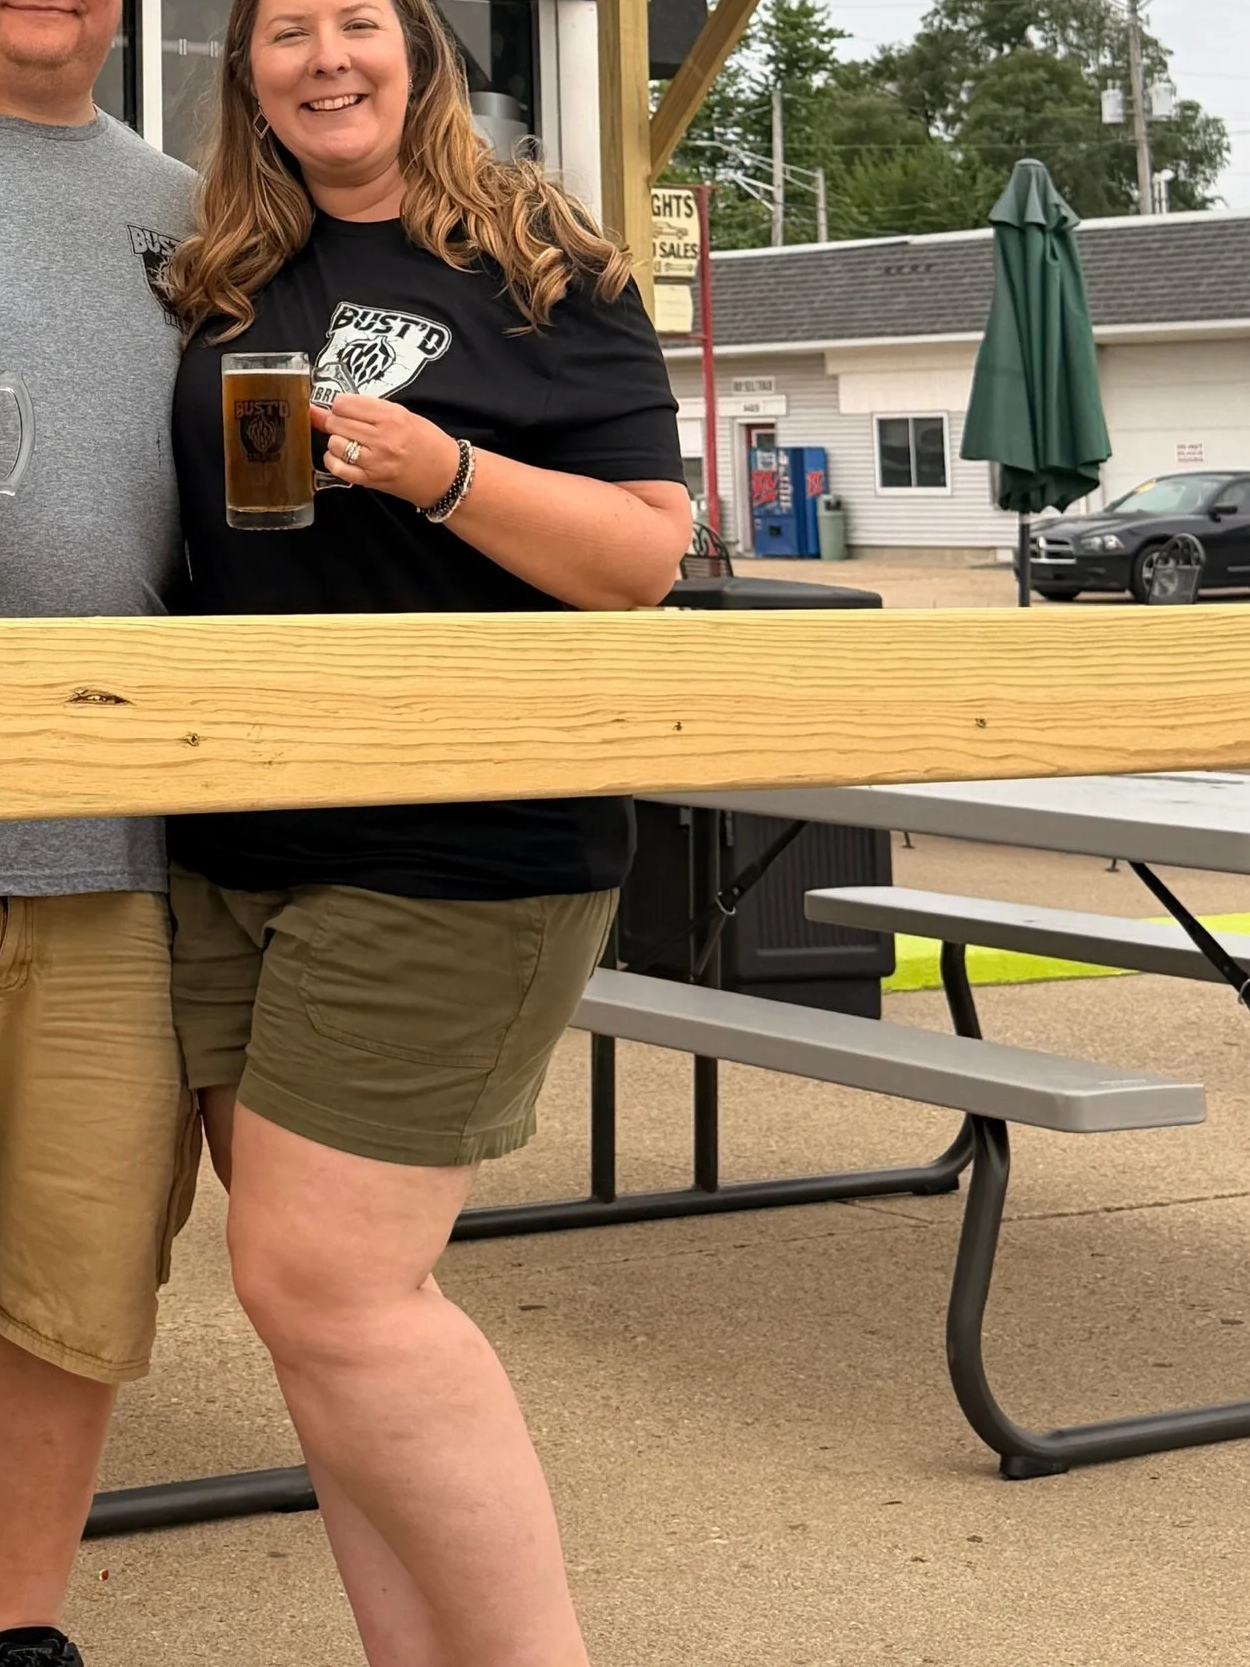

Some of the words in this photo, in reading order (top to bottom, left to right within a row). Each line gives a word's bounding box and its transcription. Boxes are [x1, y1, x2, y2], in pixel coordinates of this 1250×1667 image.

[651, 193, 694, 219] GHTS
[127, 224, 178, 255] BUS
[659, 241, 699, 260] SALES
[330, 305, 447, 357] BUST'D
